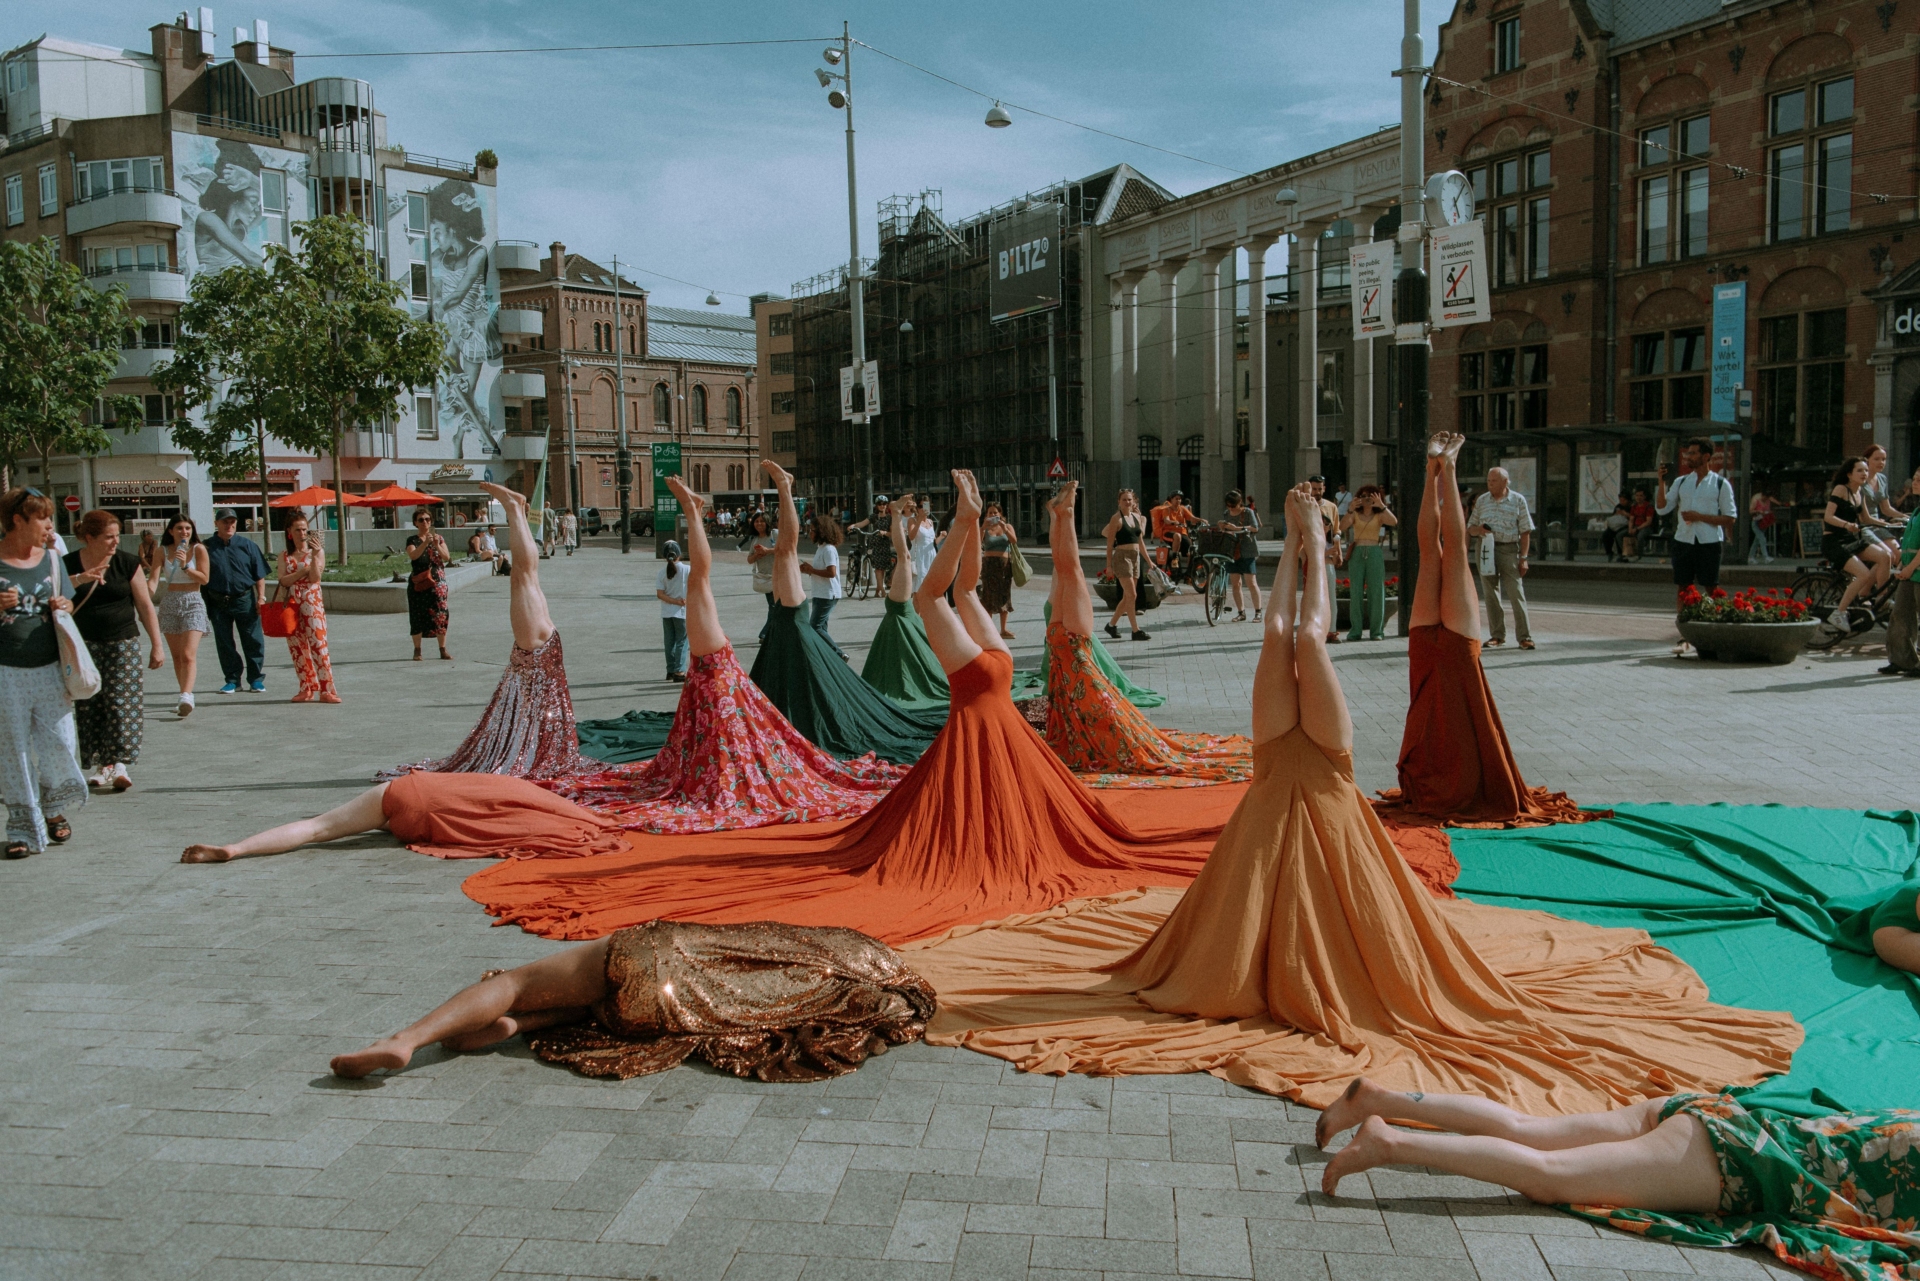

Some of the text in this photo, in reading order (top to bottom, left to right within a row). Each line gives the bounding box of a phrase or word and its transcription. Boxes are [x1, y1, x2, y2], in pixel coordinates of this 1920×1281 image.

[1125, 155, 1400, 248] HOMO SAPIENS NON URIN IN VENTUM
[1441, 239, 1474, 251] Wildplassen
[1447, 249, 1475, 260] verboden.
[1365, 259, 1380, 268] public
[1718, 350, 1736, 360] Wat
[1714, 361, 1740, 371] vertel
[654, 445, 662, 456] P
[101, 484, 177, 495] Pancake Corner
